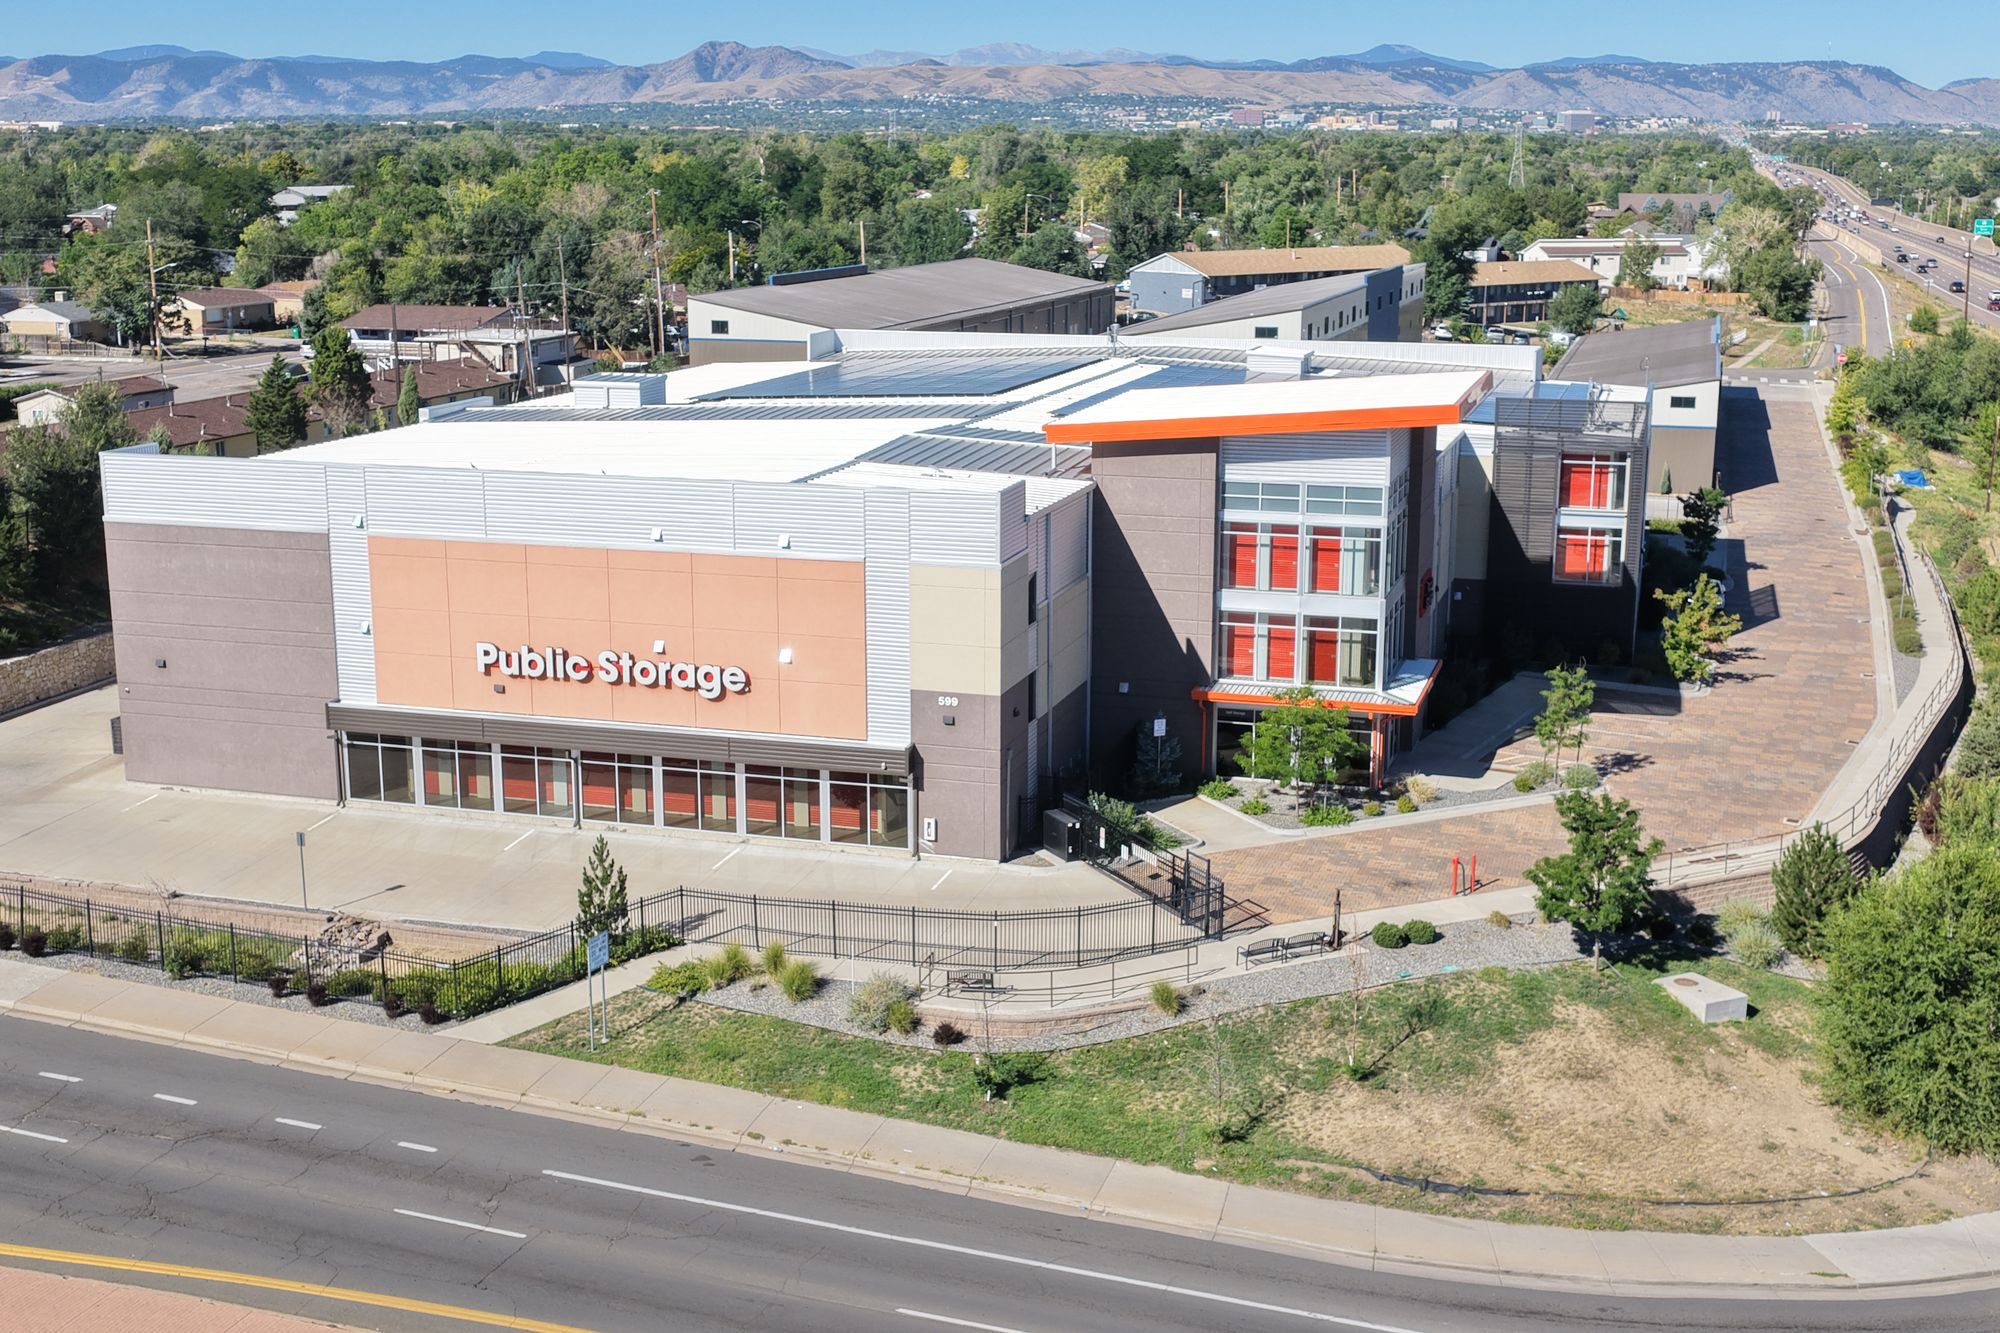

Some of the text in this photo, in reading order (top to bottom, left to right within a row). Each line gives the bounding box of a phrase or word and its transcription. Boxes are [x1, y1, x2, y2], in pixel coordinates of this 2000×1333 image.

[476, 642, 748, 699] Public Storage
[938, 696, 959, 707] 599
